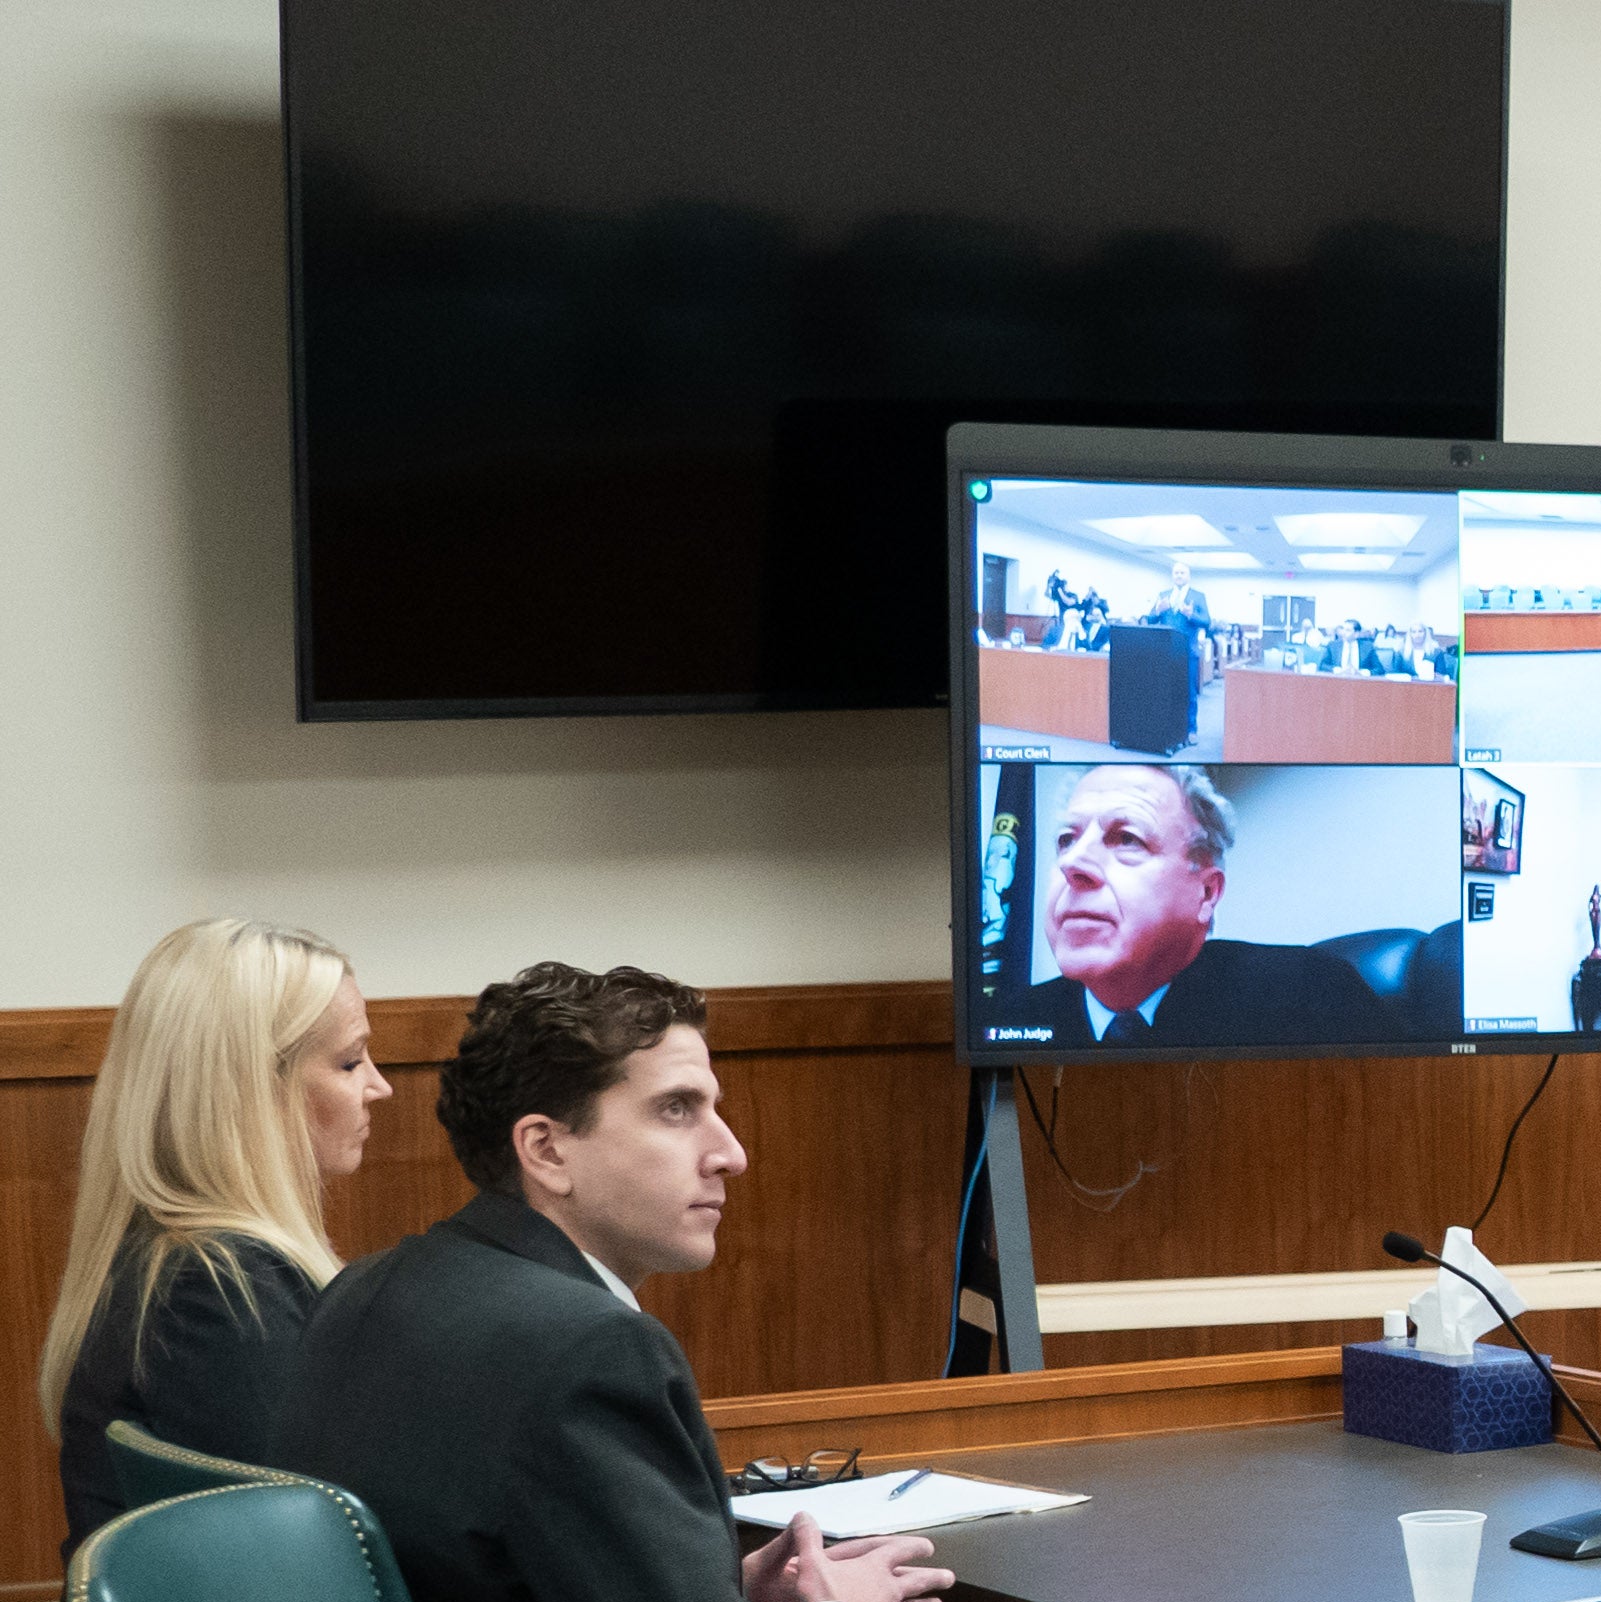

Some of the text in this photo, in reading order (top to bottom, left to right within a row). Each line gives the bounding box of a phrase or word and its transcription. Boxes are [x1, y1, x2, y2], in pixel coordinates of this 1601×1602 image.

[995, 747, 1050, 759] Court Clerk
[998, 1027, 1053, 1042] John Judge
